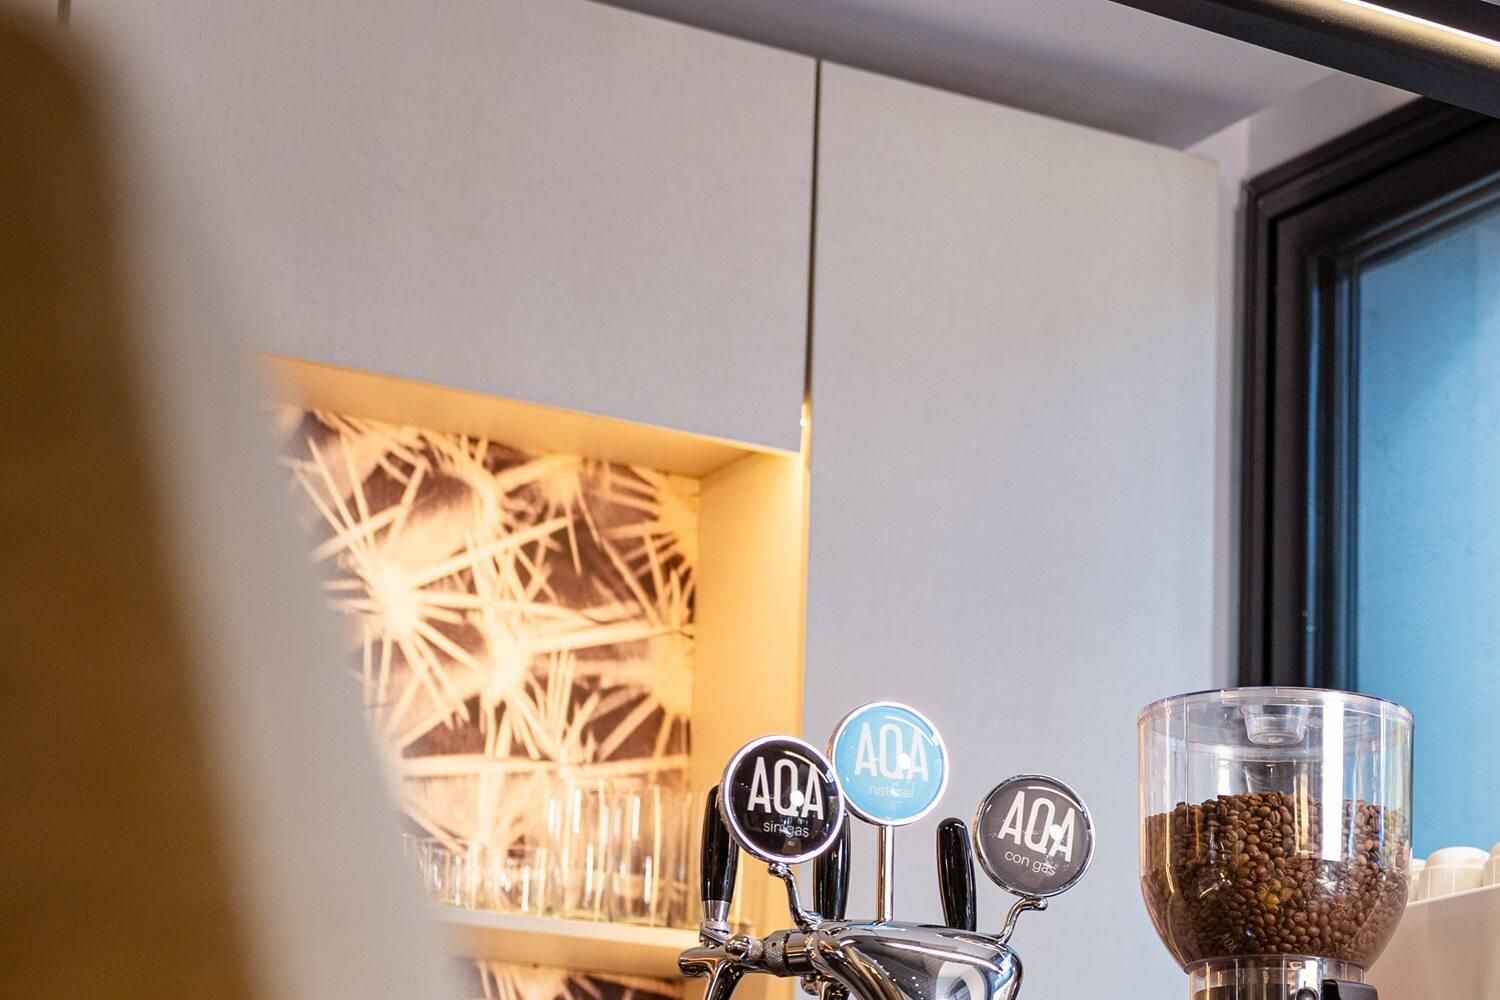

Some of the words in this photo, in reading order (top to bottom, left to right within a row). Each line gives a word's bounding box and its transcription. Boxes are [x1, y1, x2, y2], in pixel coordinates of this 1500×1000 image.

[854, 722, 928, 781] AQA
[747, 756, 824, 820] AQA
[787, 823, 809, 838] gas
[998, 791, 1075, 862] AQA
[1004, 851, 1030, 867] con
[1031, 860, 1057, 876] gas
